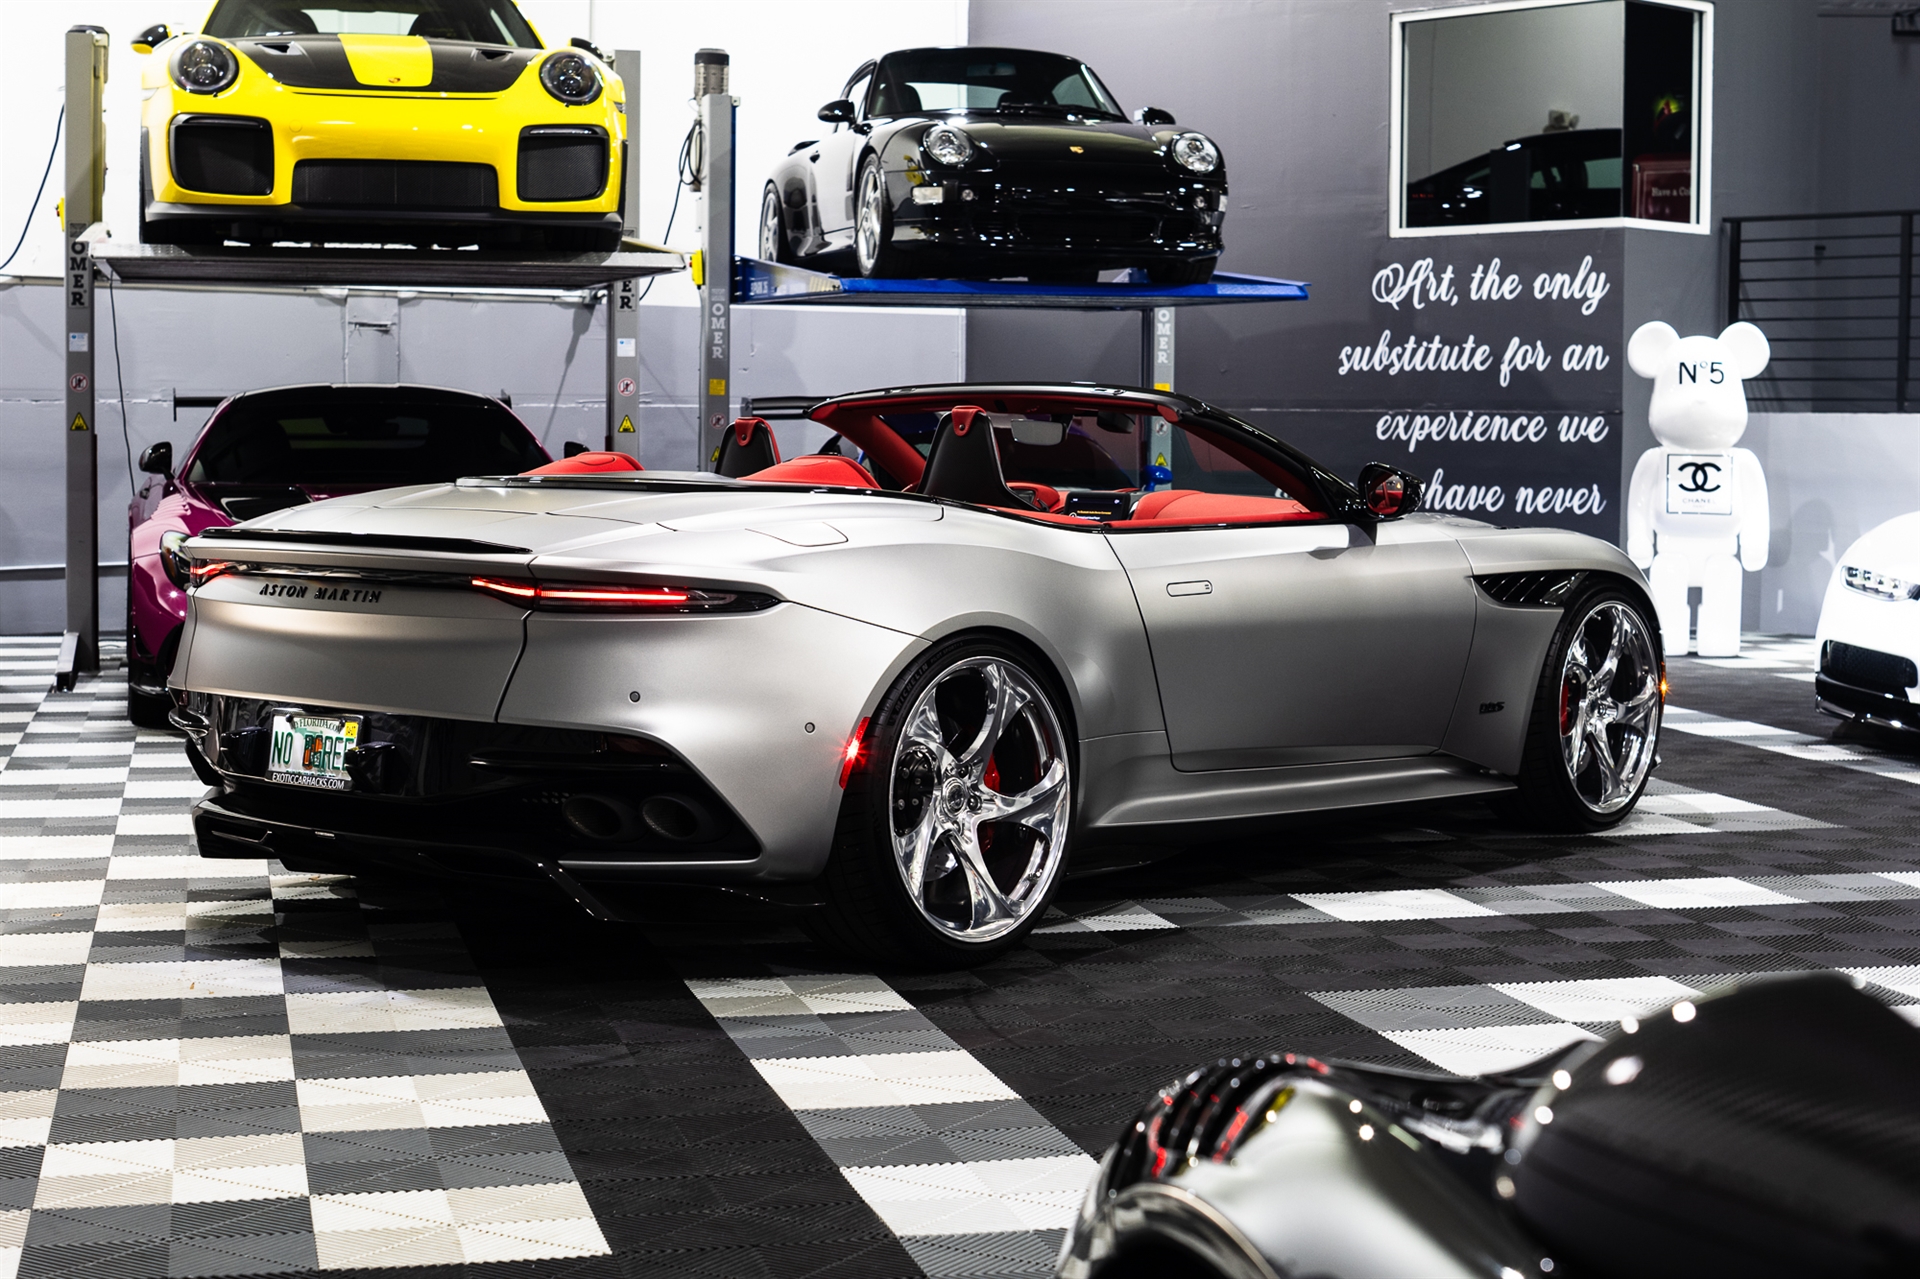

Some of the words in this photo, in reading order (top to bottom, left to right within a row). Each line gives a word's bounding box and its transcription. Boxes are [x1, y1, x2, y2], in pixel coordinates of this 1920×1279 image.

[70, 242, 87, 306] OMER
[1470, 257, 1522, 301] the
[1533, 255, 1610, 315] only
[711, 303, 726, 359] OMER
[1157, 309, 1171, 364] OMER
[1338, 329, 1493, 375] substitute
[1500, 336, 1551, 387] for
[1562, 344, 1609, 371] an
[1376, 410, 1547, 453] experience
[1557, 415, 1609, 443] we
[1424, 468, 1505, 512] have
[1515, 484, 1607, 515] never
[260, 583, 308, 598] ASTON
[314, 587, 382, 603] MARTIN
[895, 663, 929, 712] MICHELIN
[272, 731, 294, 765] NO
[272, 772, 345, 789] EXOTICCARHACKS.COM
